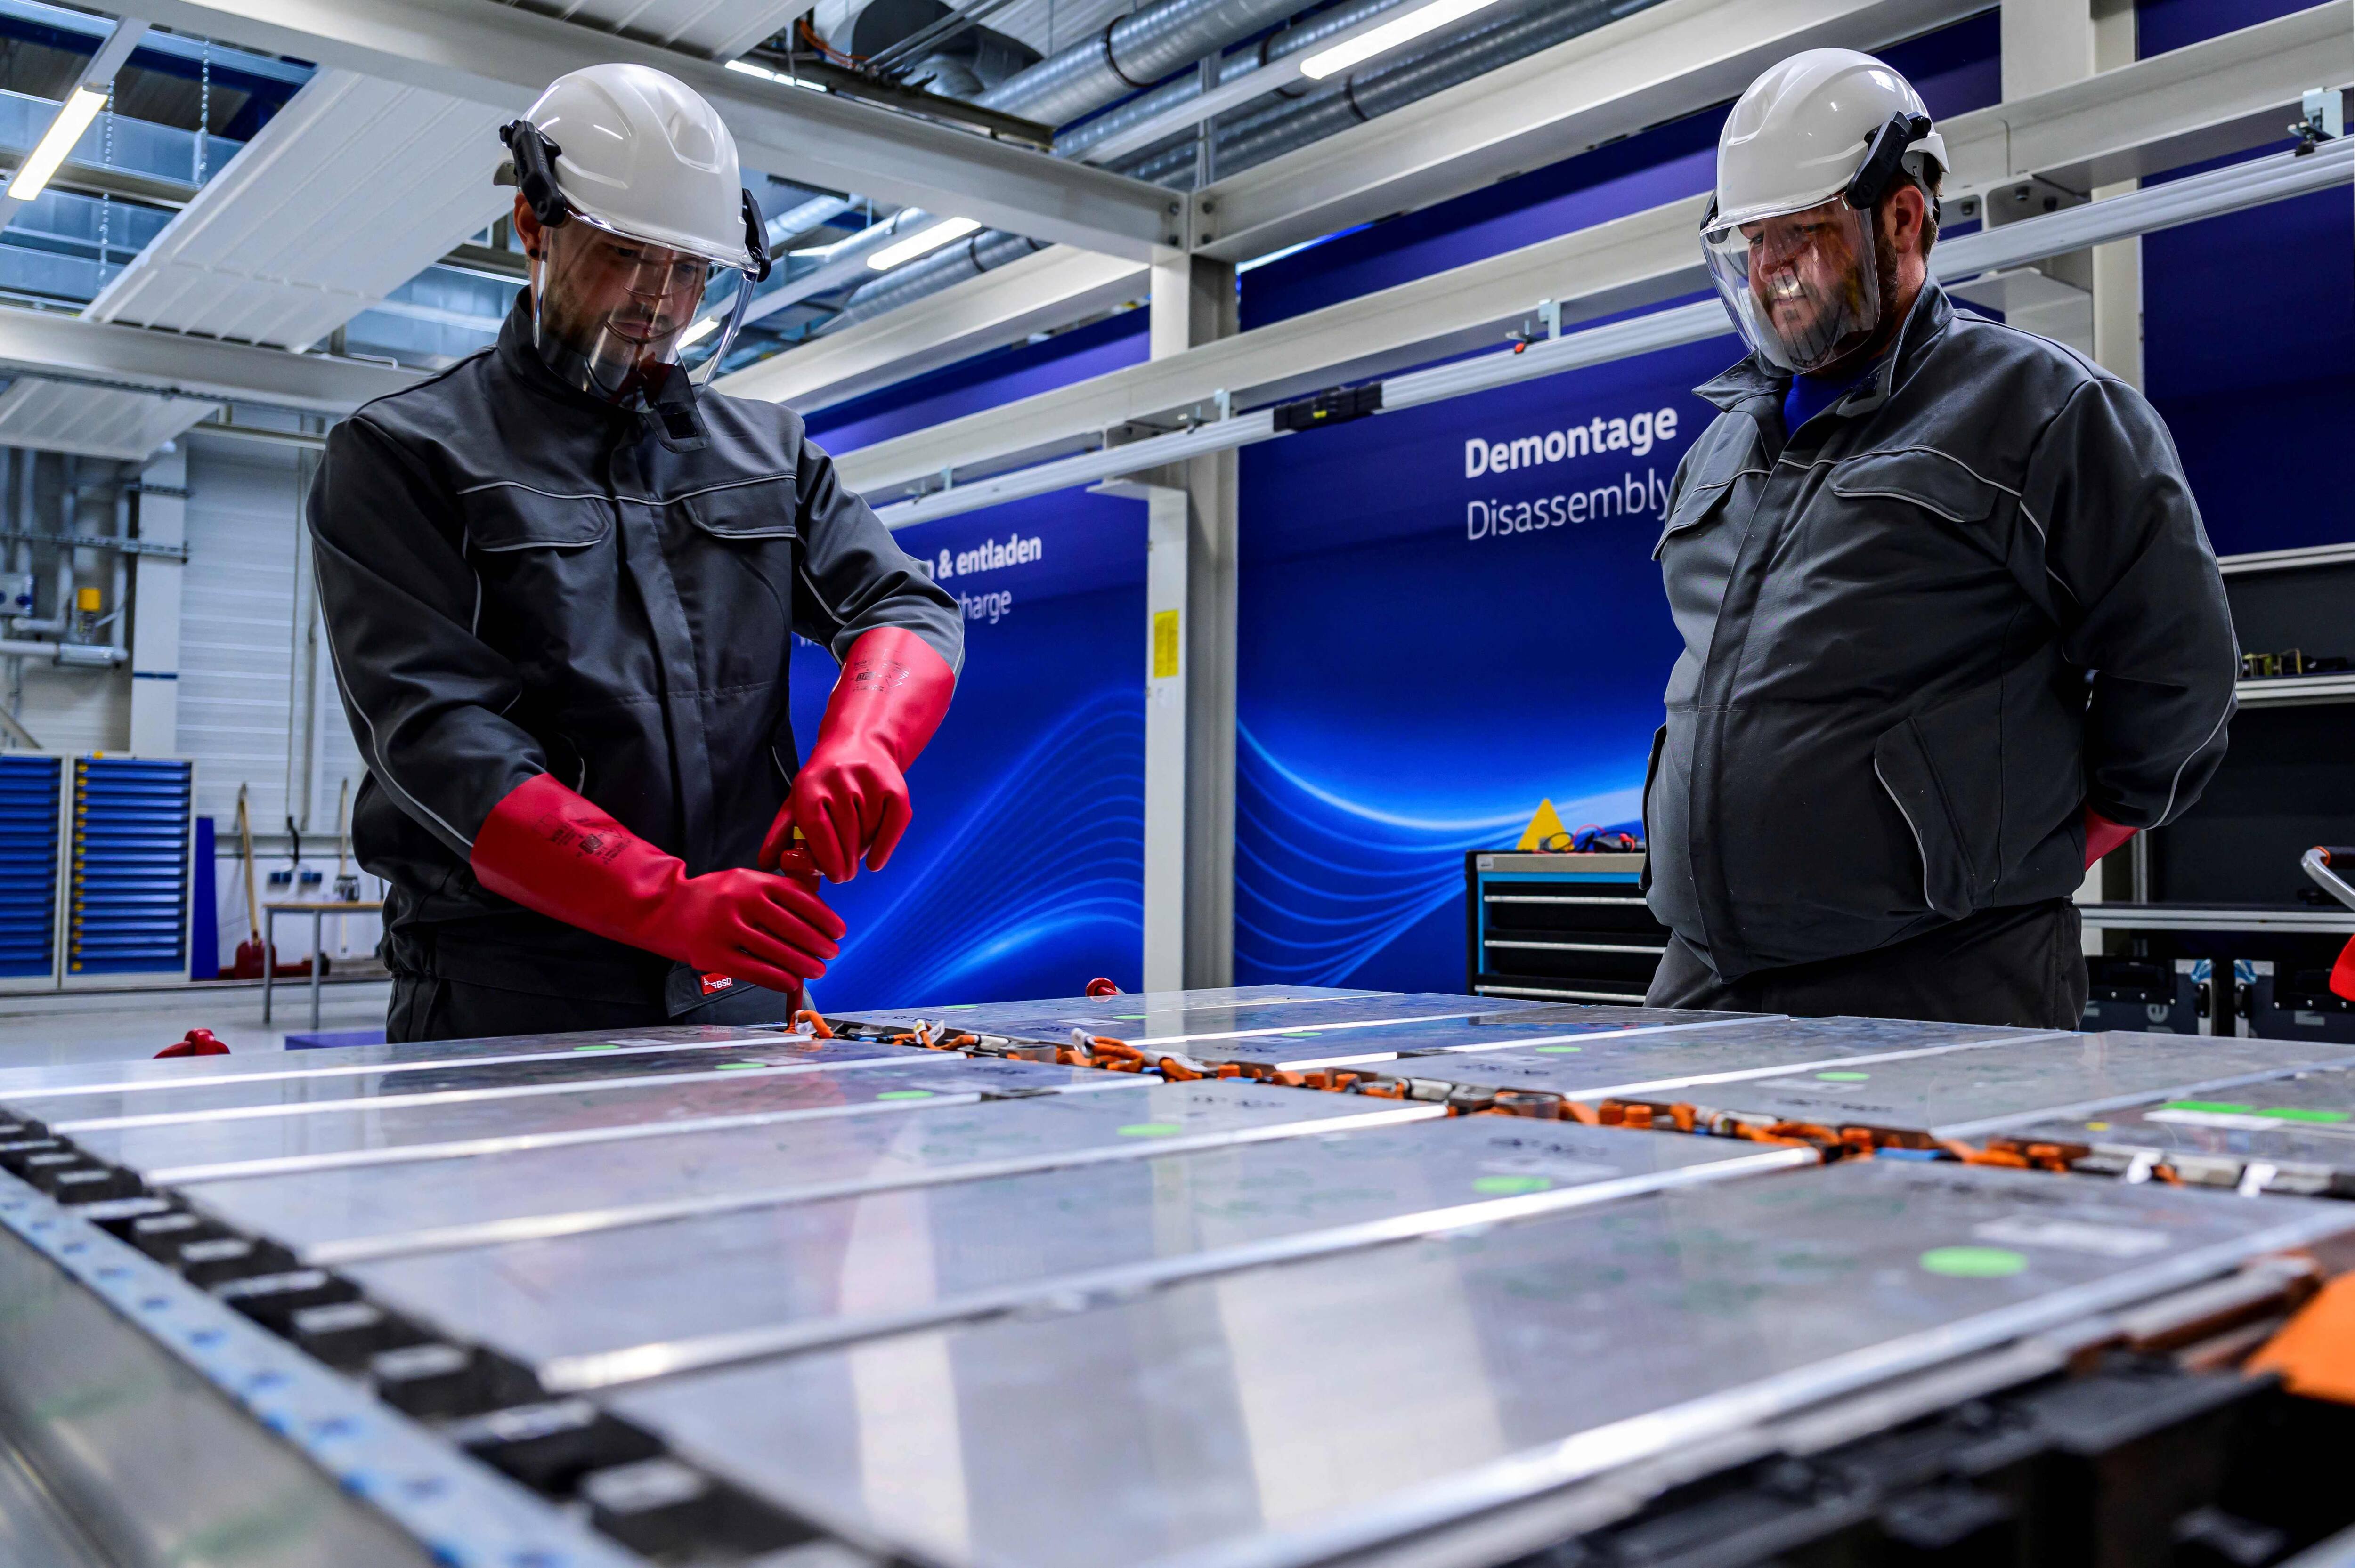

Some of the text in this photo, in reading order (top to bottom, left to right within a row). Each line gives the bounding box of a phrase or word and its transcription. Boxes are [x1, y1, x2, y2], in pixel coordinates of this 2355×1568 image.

[1465, 407, 1678, 479] Demontage
[1467, 468, 1670, 541] Disassembly
[938, 549, 954, 580] &
[956, 533, 1042, 576] entladen
[956, 590, 1012, 625] harge
[716, 977, 732, 989] BSD
